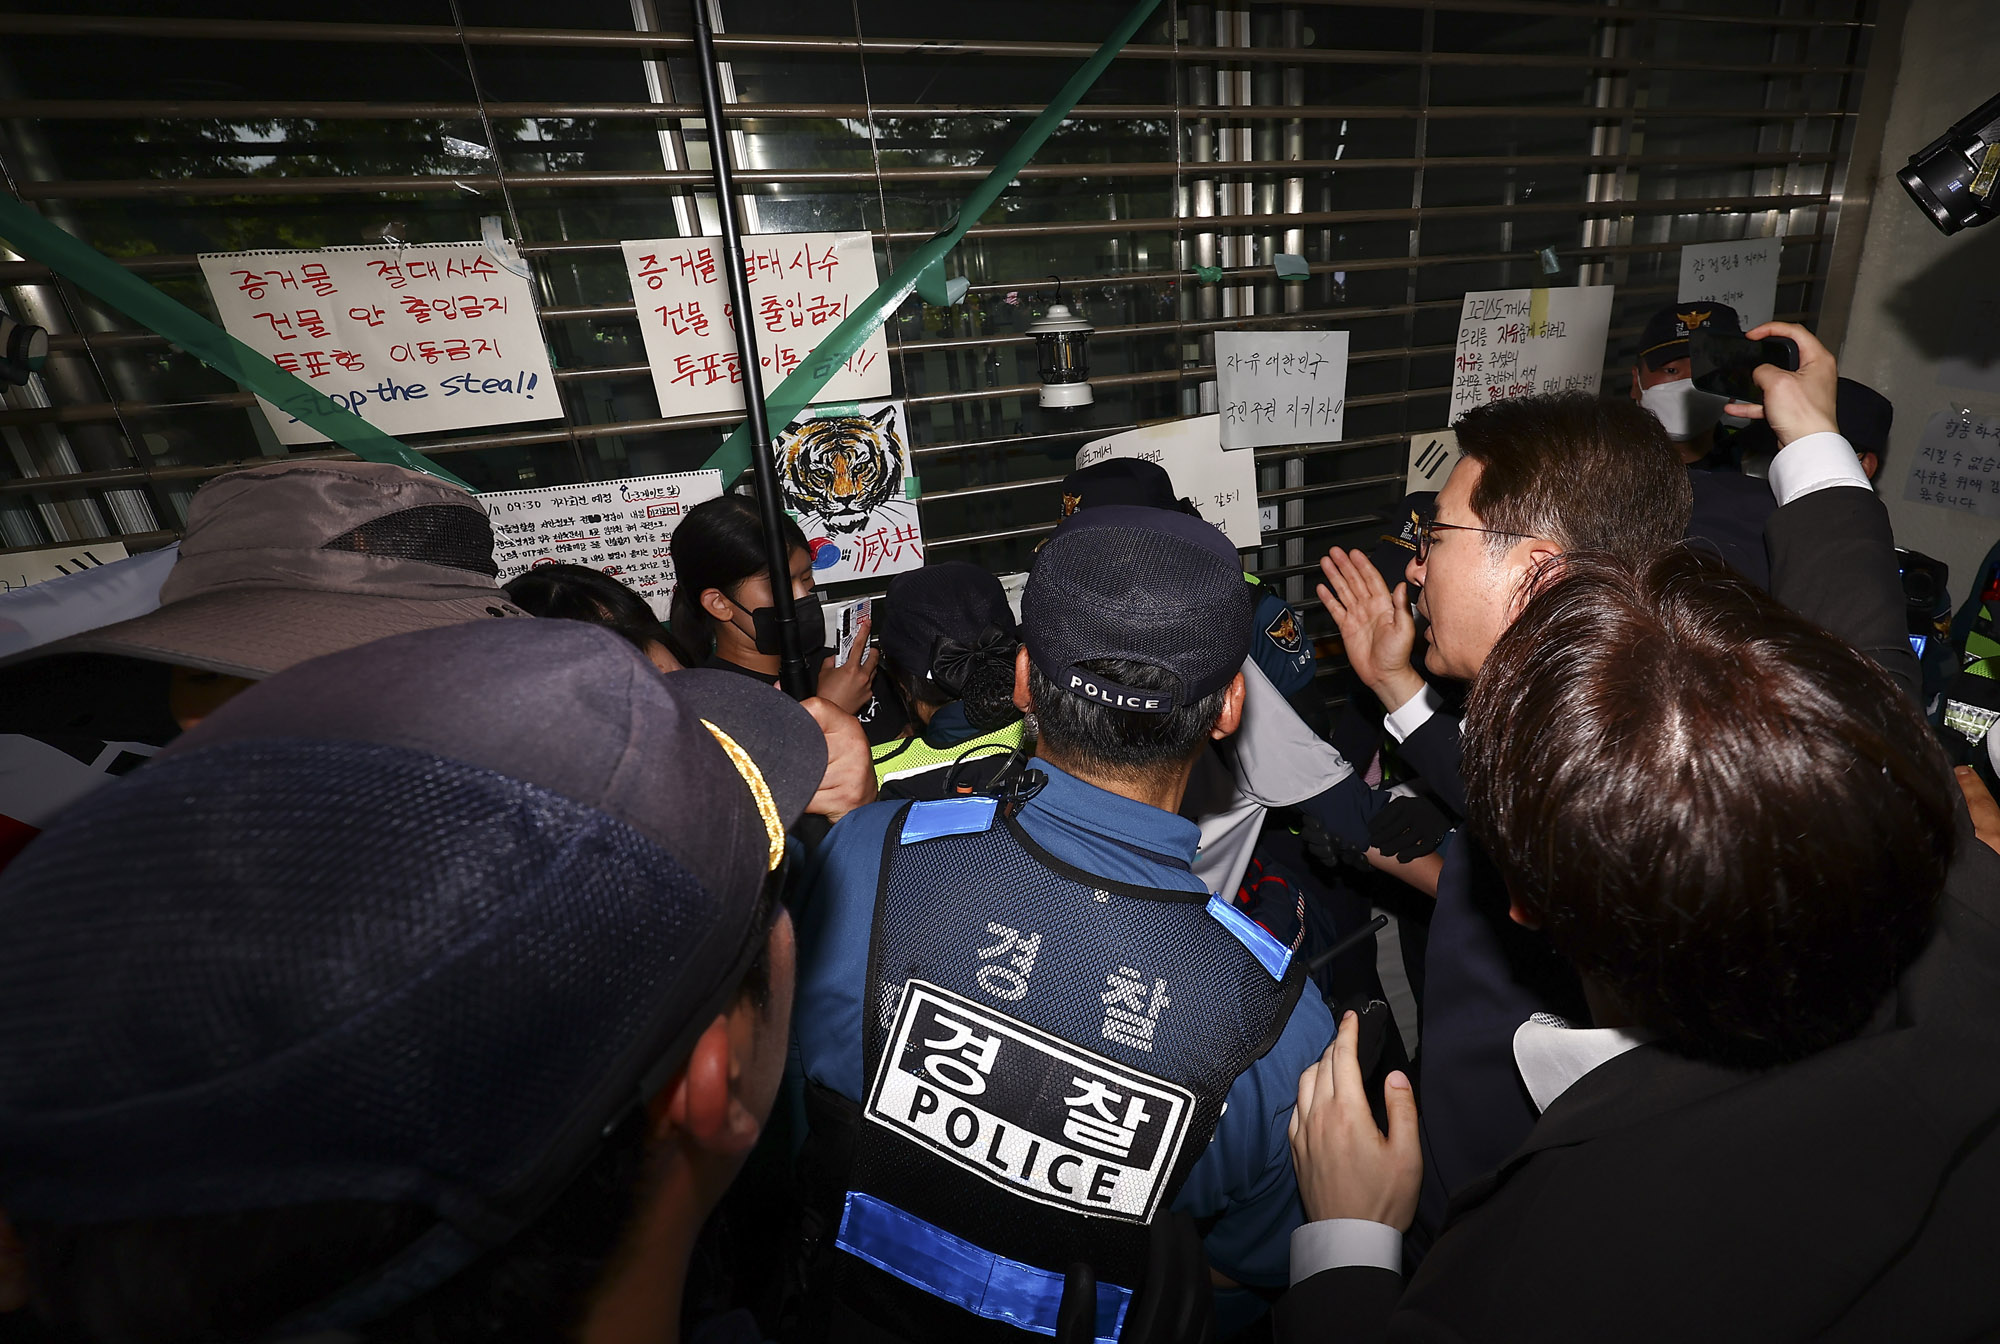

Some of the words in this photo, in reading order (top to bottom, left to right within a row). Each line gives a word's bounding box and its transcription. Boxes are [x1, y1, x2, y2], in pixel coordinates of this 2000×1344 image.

[230, 264, 338, 300] 증거물
[367, 255, 499, 289] 절대사수
[638, 248, 718, 290] 증거물
[253, 309, 331, 340] 건물
[349, 304, 385, 328] 안
[400, 295, 508, 324] 출입금지
[654, 300, 710, 337] 건물
[759, 291, 849, 333] 출입금지
[390, 338, 502, 364] 이동금지
[1460, 327, 1487, 351] 우리를
[1497, 322, 1536, 344] 자유롭게
[1456, 352, 1483, 373] 자유를
[367, 377, 429, 403] the
[440, 370, 539, 400] steal!!
[1286, 395, 1343, 428] 지키자!
[507, 500, 541, 512] 09:30
[551, 495, 589, 508] 기자회견
[592, 492, 612, 503] 예정
[853, 523, 924, 573] 滅共
[1070, 675, 1160, 709] POLICE
[907, 1084, 1123, 1204] POLICE
